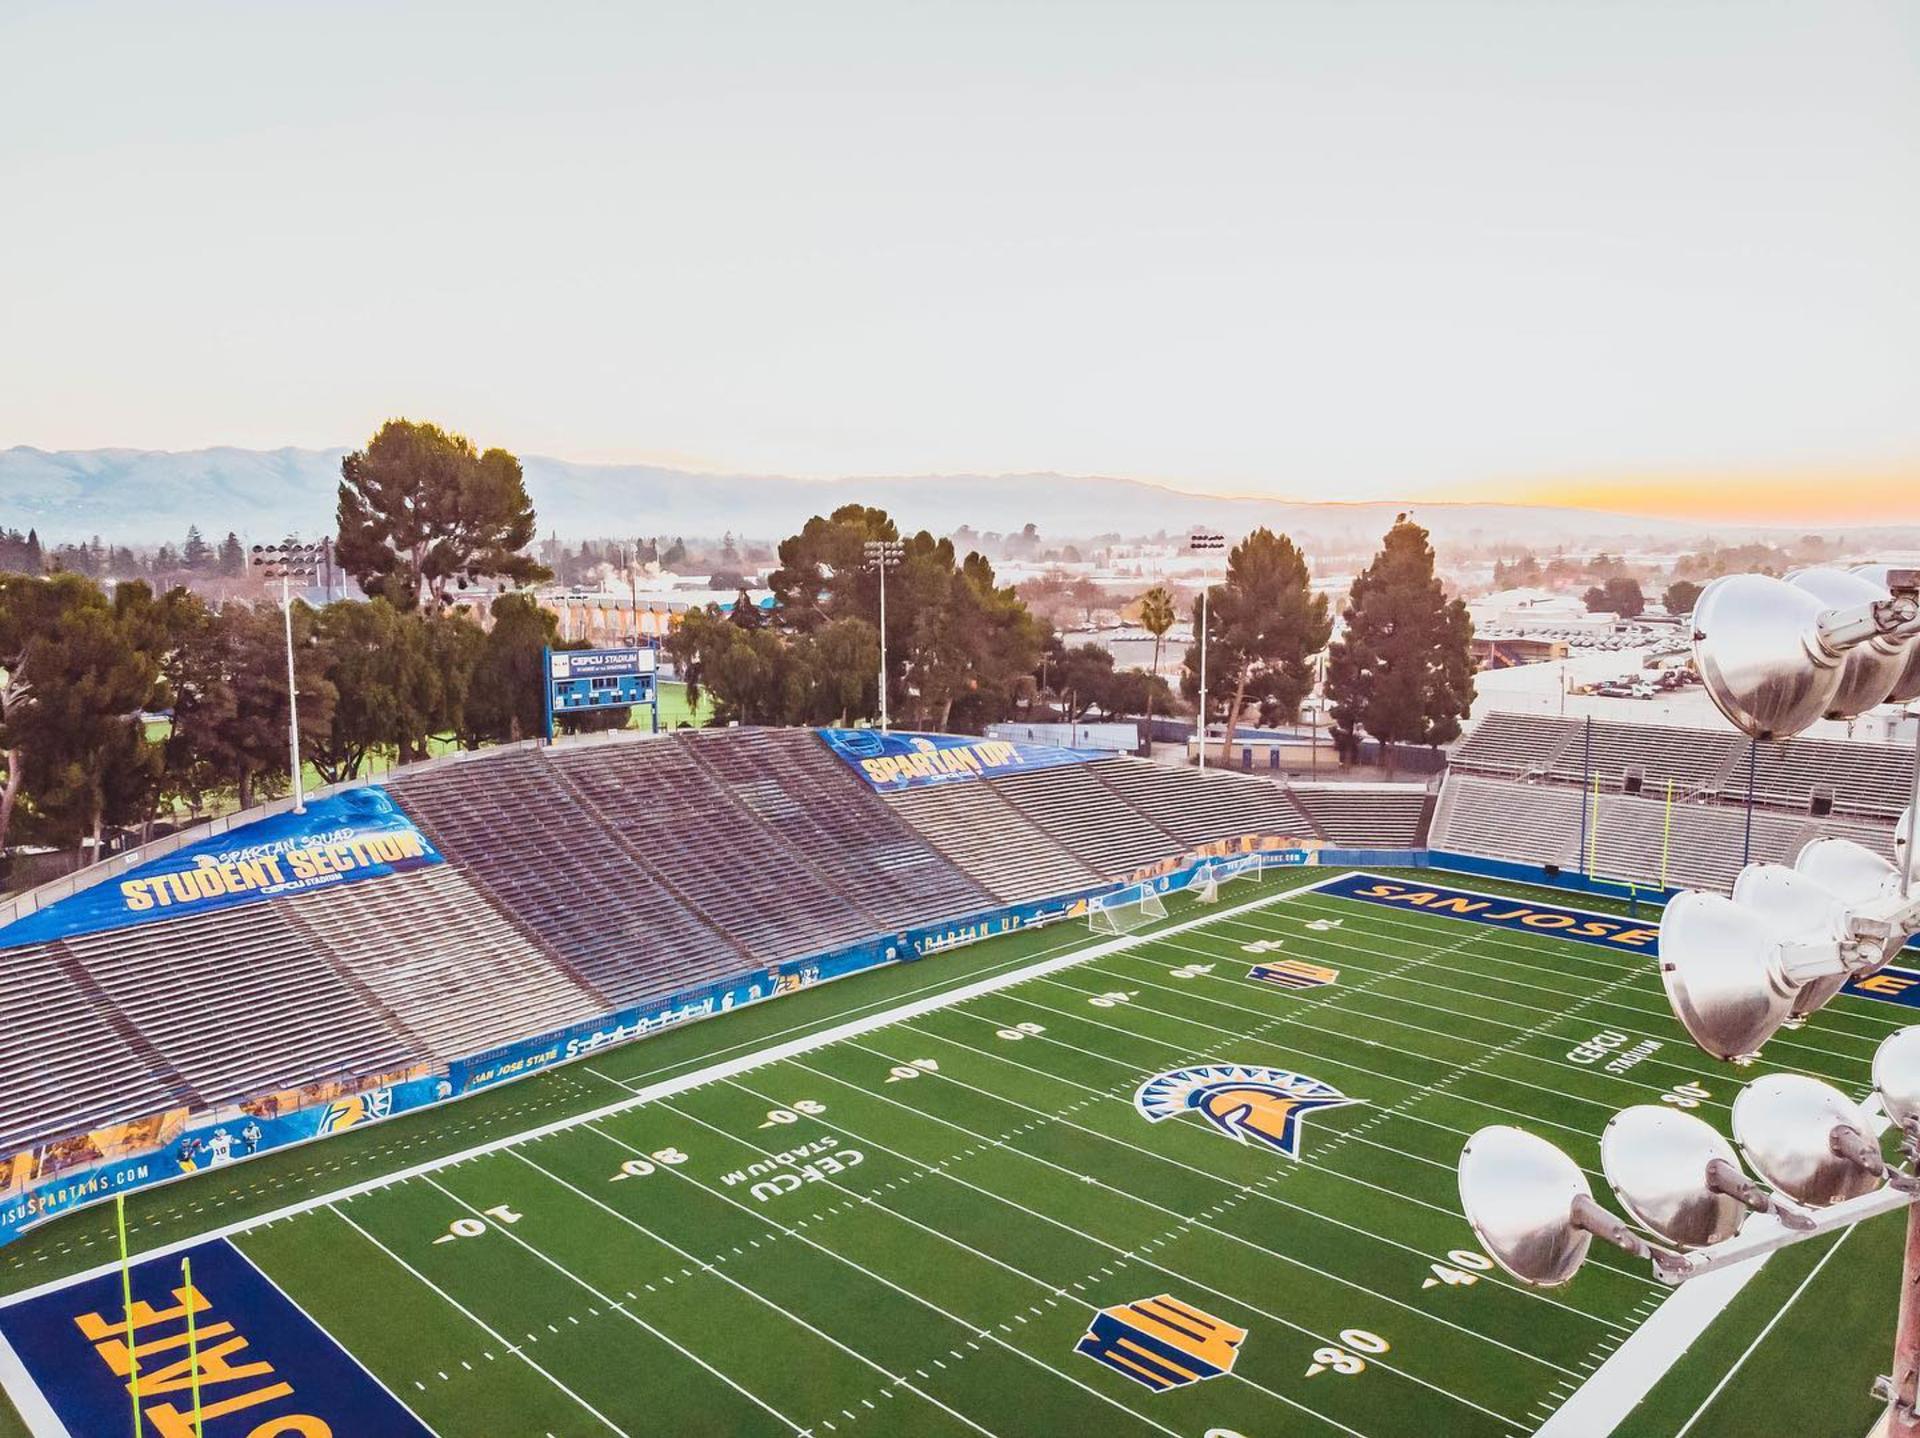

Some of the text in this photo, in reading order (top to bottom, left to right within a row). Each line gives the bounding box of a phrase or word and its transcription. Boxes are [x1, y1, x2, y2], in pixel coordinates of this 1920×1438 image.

[861, 741, 1024, 783] SPARTAN UP!
[219, 827, 355, 864] SPARTAN SQUAD
[120, 831, 425, 911] STUDENT SECTION
[1353, 885, 1492, 912] SAN
[1002, 915, 1020, 930] UP
[526, 1049, 558, 1067] STATE
[1566, 1030, 1628, 1064] CEFCU
[1605, 1039, 1664, 1074] STADIUM
[720, 1136, 838, 1186] STADIUM
[750, 1150, 864, 1202] CEFCU
[449, 1204, 523, 1237] 10
[1430, 1250, 1494, 1286] 40
[1313, 1328, 1390, 1374] 30
